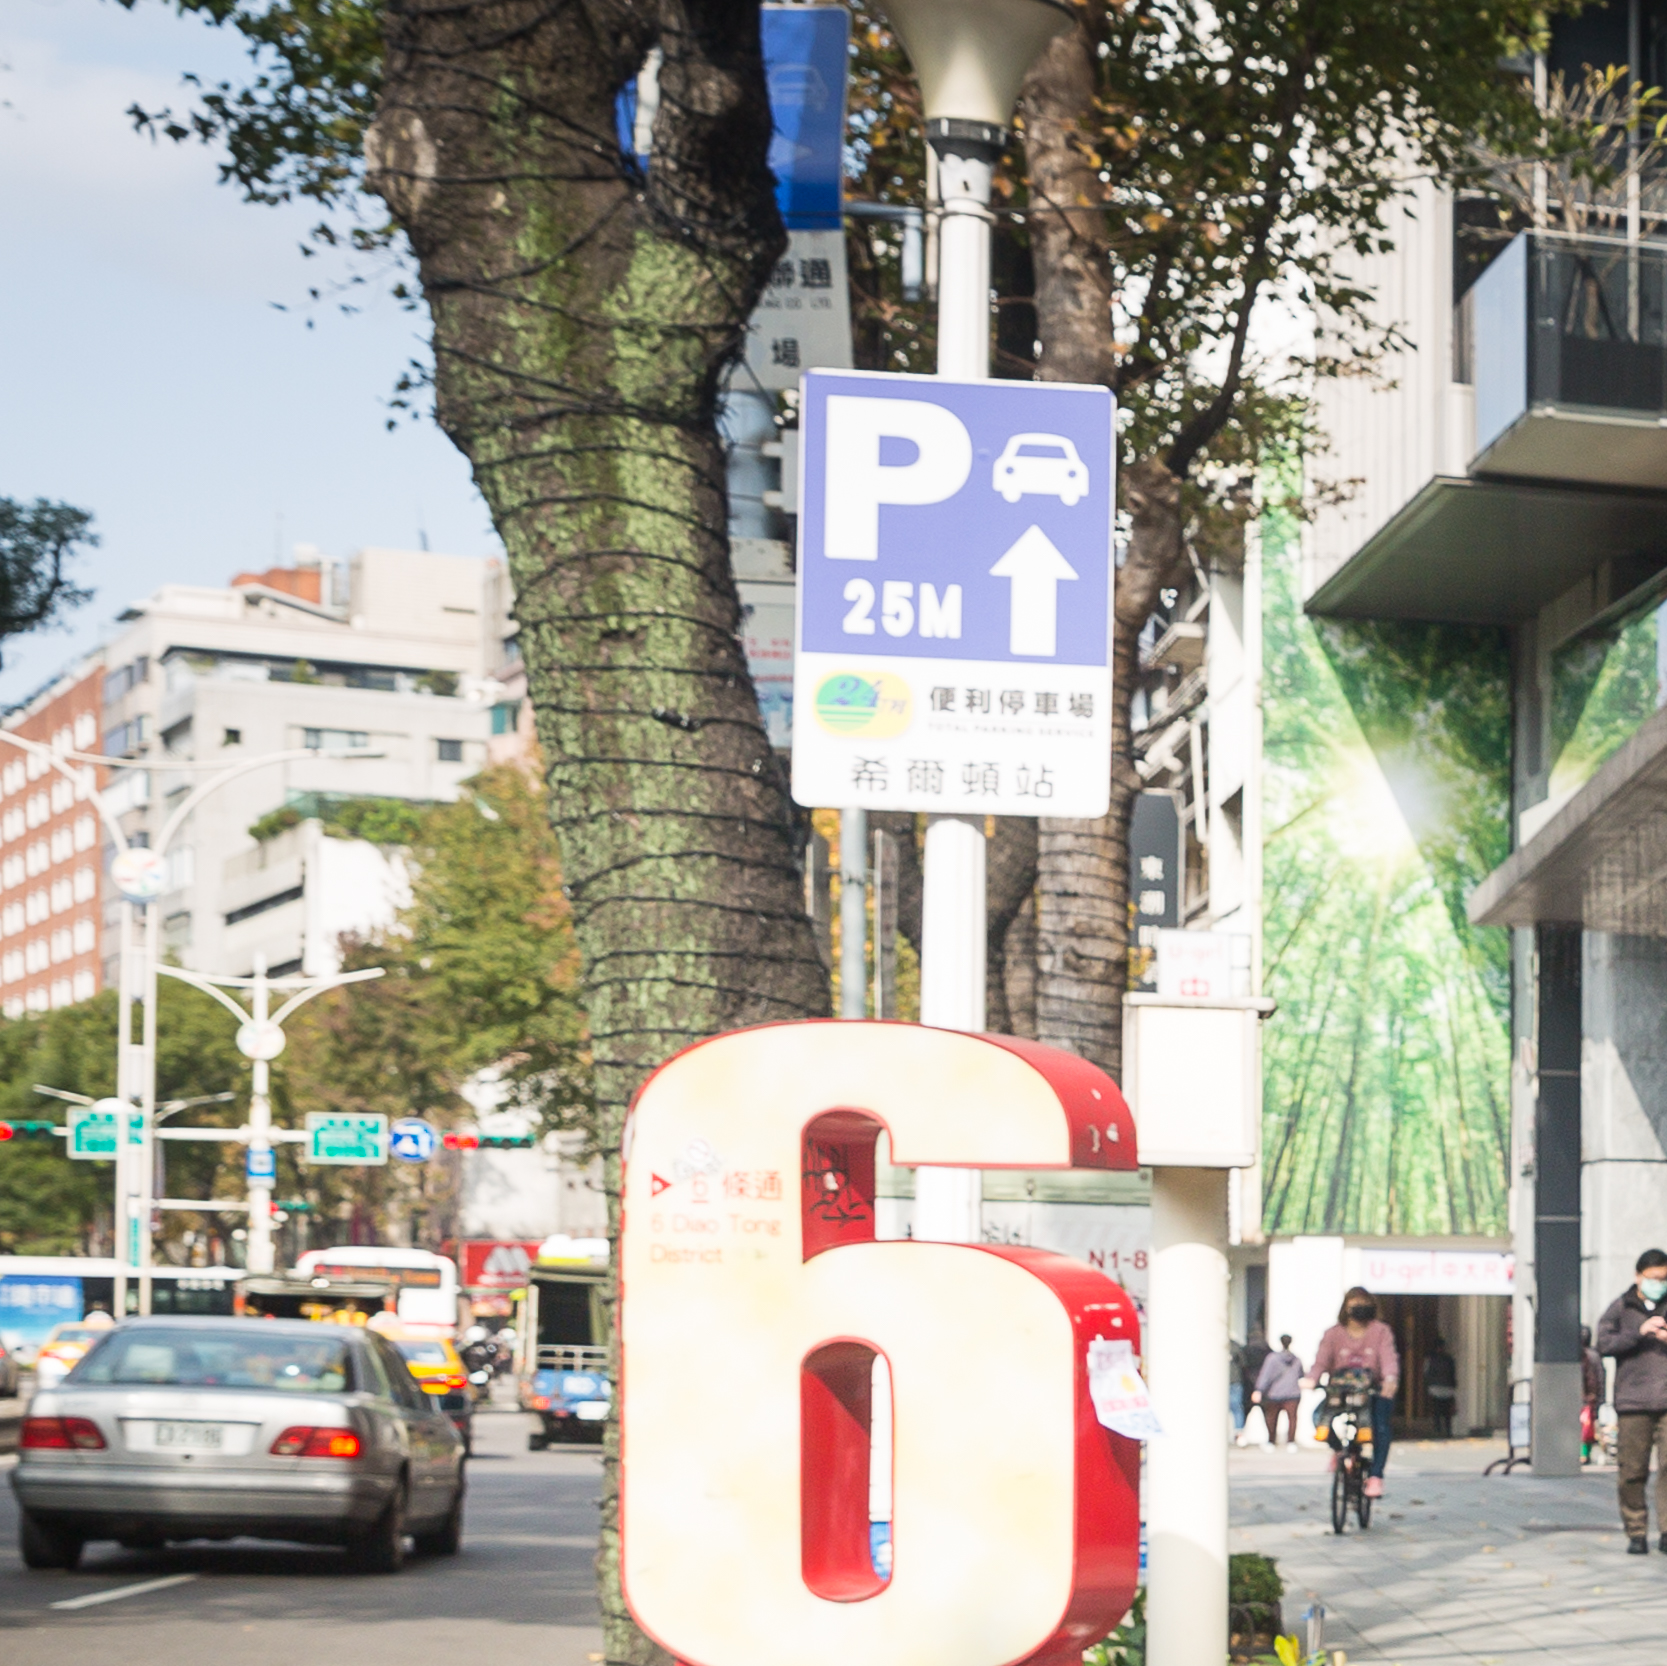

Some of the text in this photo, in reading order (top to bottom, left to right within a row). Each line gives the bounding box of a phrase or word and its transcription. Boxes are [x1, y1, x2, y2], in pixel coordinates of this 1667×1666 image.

[823, 394, 973, 561] P
[842, 578, 963, 640] 25M
[929, 685, 1095, 719] 便利停車場
[851, 755, 1054, 800] 希爾頓站
[1088, 1249, 1149, 1270] N1-8
